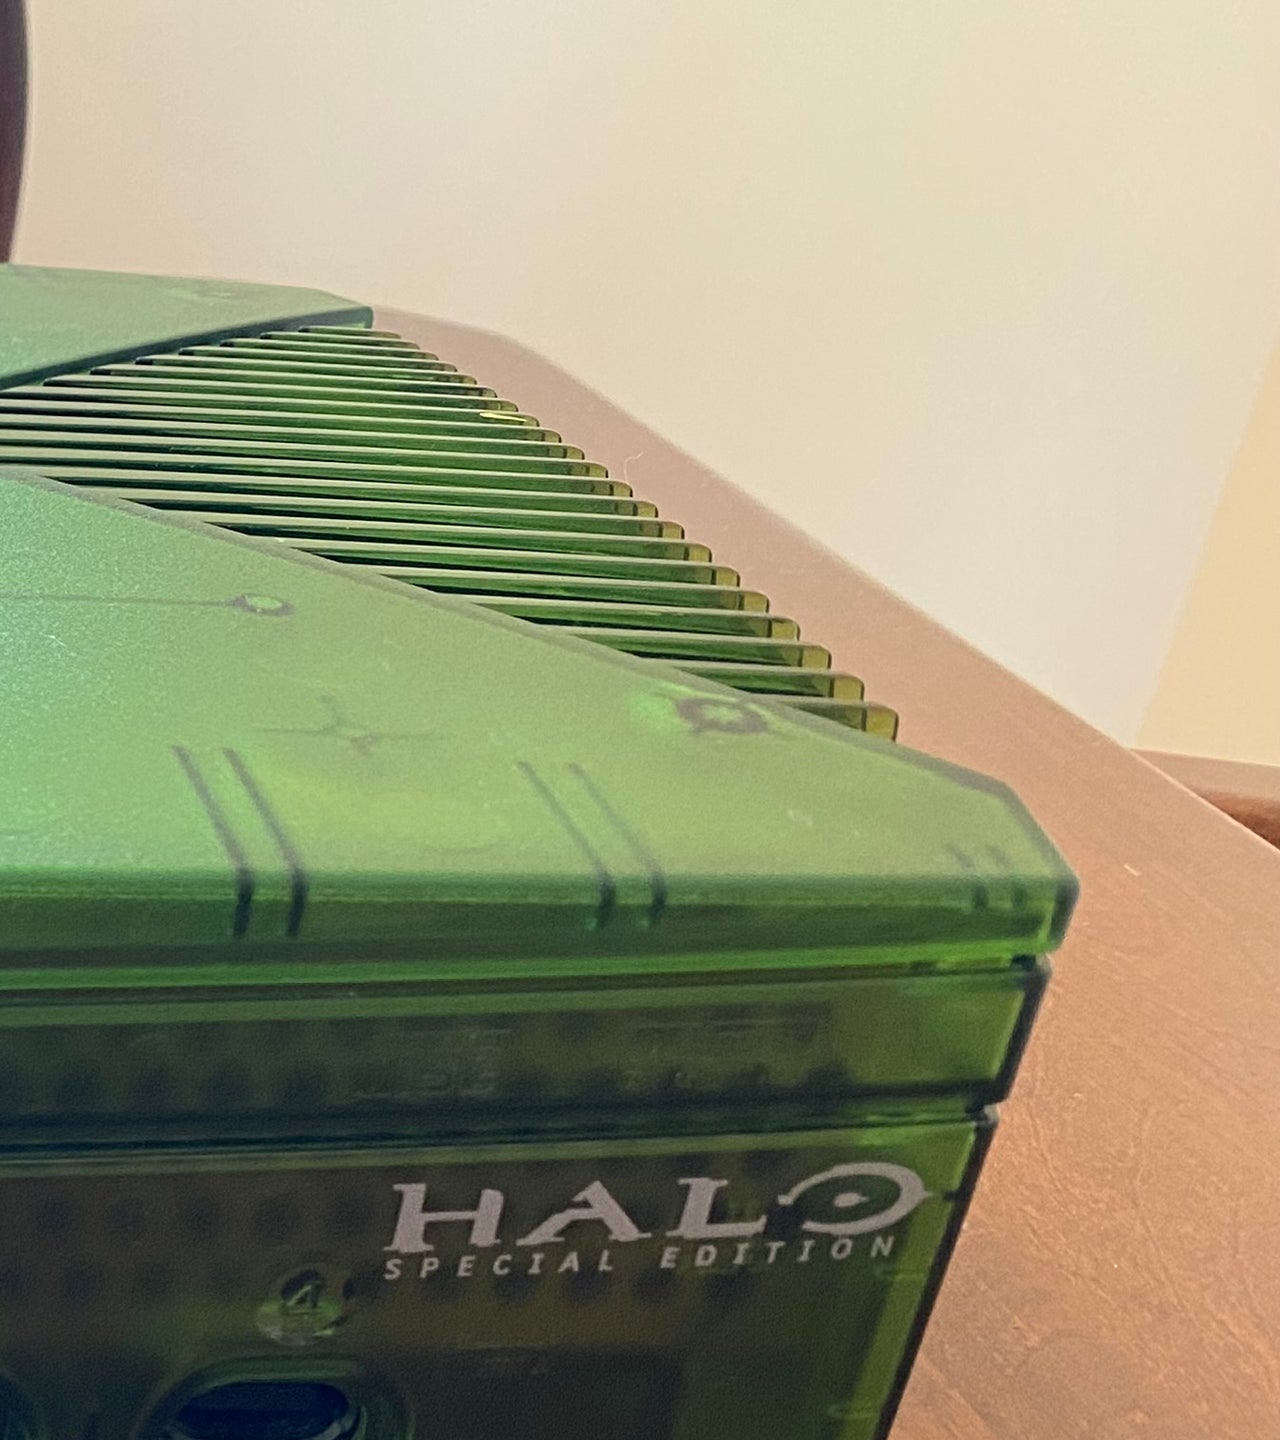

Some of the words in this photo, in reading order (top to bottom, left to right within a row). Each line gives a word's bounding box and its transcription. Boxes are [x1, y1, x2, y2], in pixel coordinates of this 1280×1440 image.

[383, 1161, 935, 1253] HALO
[383, 1250, 615, 1281] SPECIAL
[660, 1234, 898, 1270] EDITION
